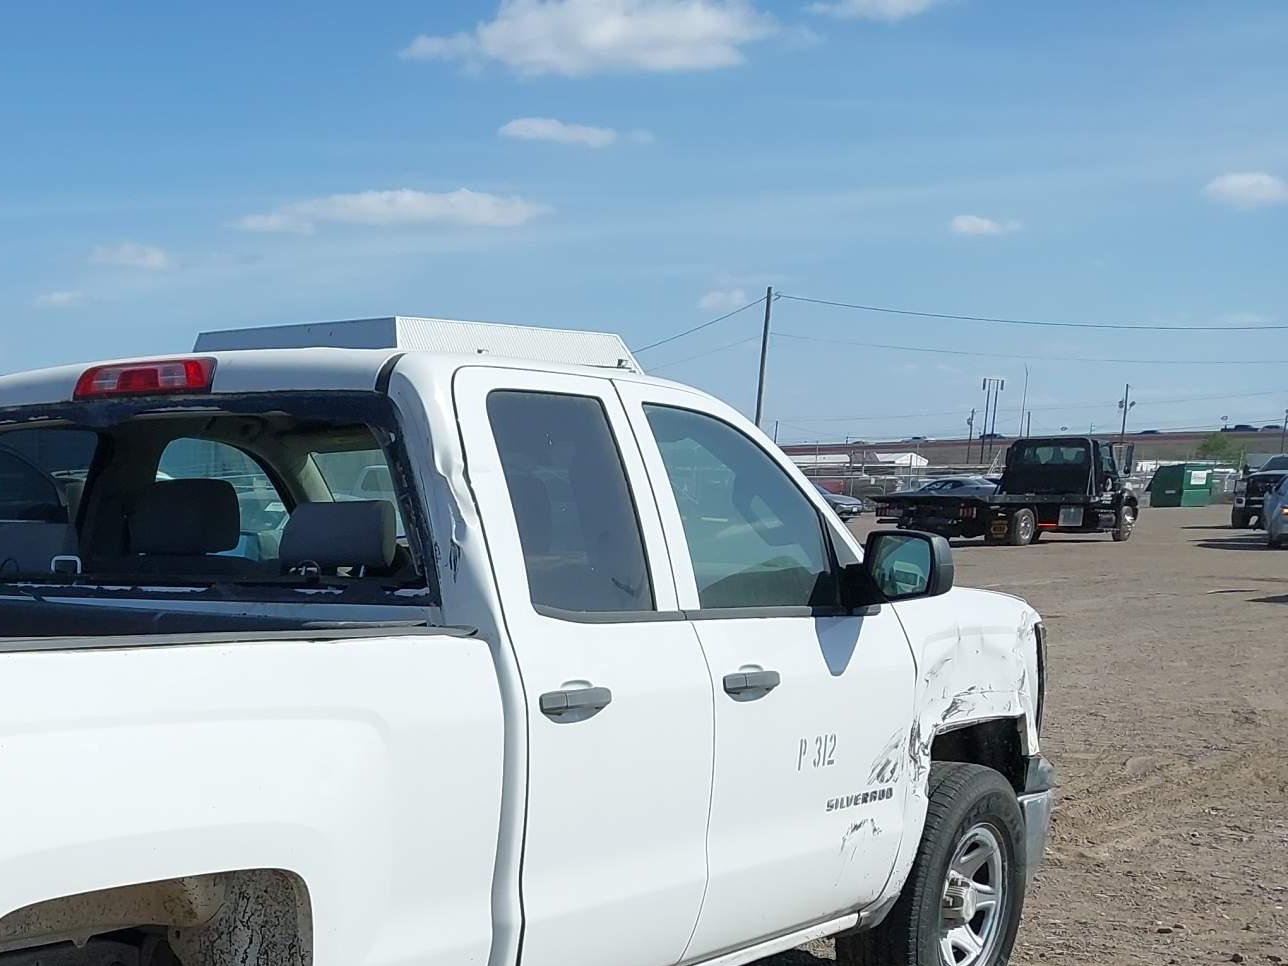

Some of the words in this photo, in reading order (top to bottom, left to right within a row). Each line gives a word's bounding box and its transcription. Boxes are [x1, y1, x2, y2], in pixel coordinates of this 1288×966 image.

[797, 738, 808, 771] P
[812, 733, 837, 769] 312
[825, 786, 894, 812] SILVERADO
